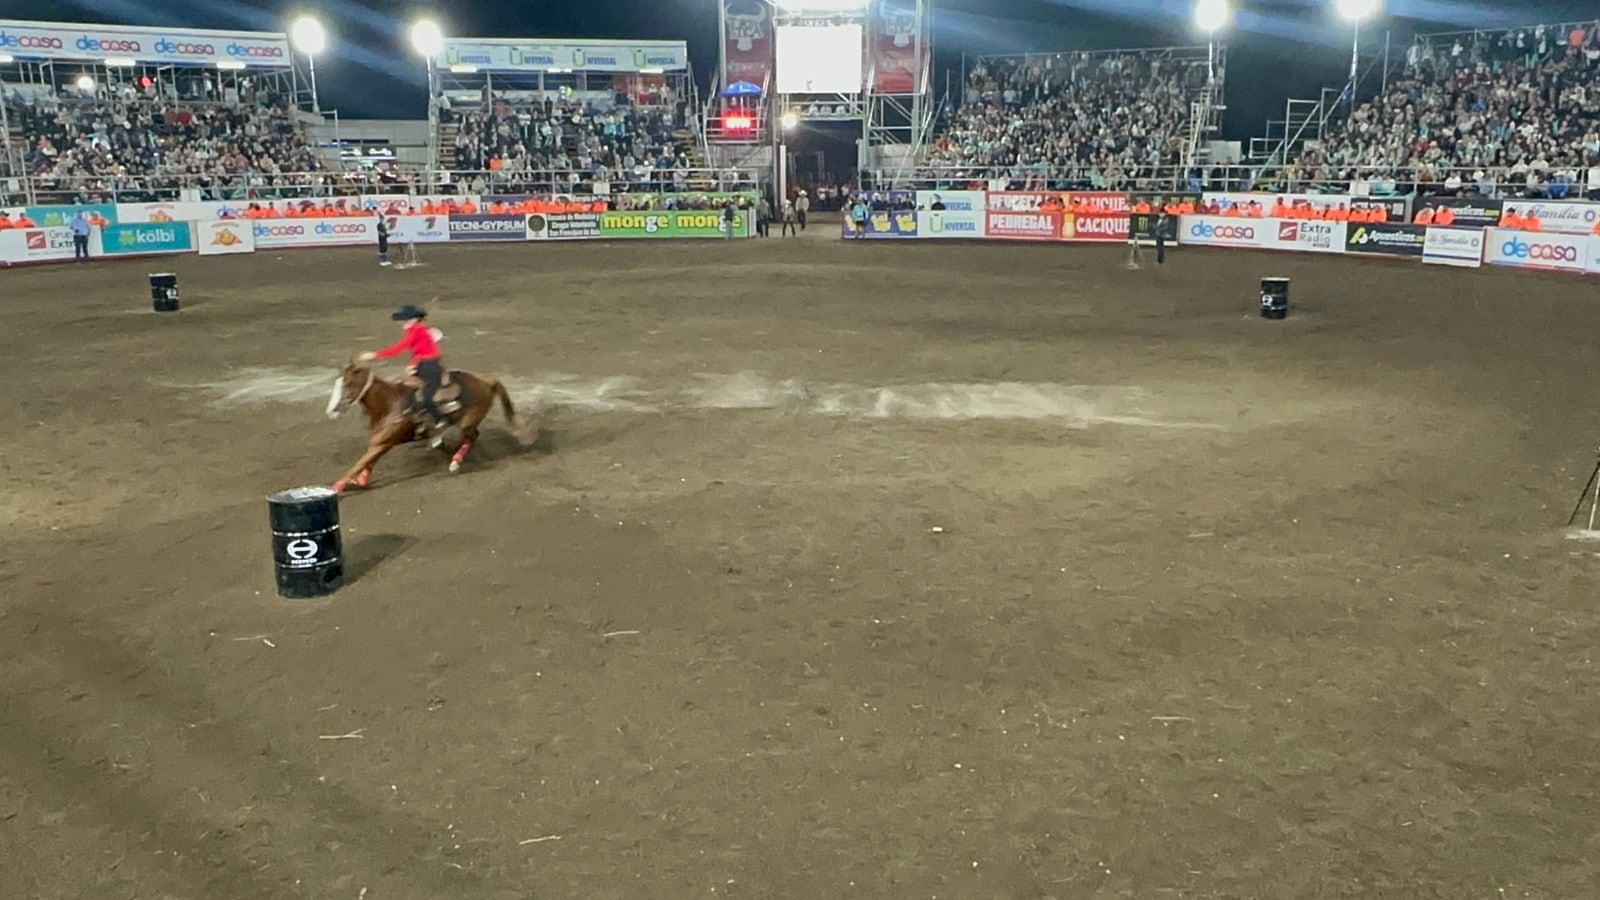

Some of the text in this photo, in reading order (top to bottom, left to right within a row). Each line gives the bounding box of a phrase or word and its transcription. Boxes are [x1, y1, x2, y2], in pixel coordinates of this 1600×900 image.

[77, 35, 141, 52] decasa
[155, 38, 215, 55] decasa
[227, 42, 283, 57] decasa
[315, 221, 367, 234] decasa
[450, 220, 525, 231] TECNI-GYPSUM
[604, 215, 669, 232] monge
[1076, 217, 1130, 234] CACIQUE
[1191, 220, 1254, 239] decasa
[1300, 222, 1331, 234] Extra
[1502, 236, 1577, 262] decasa
